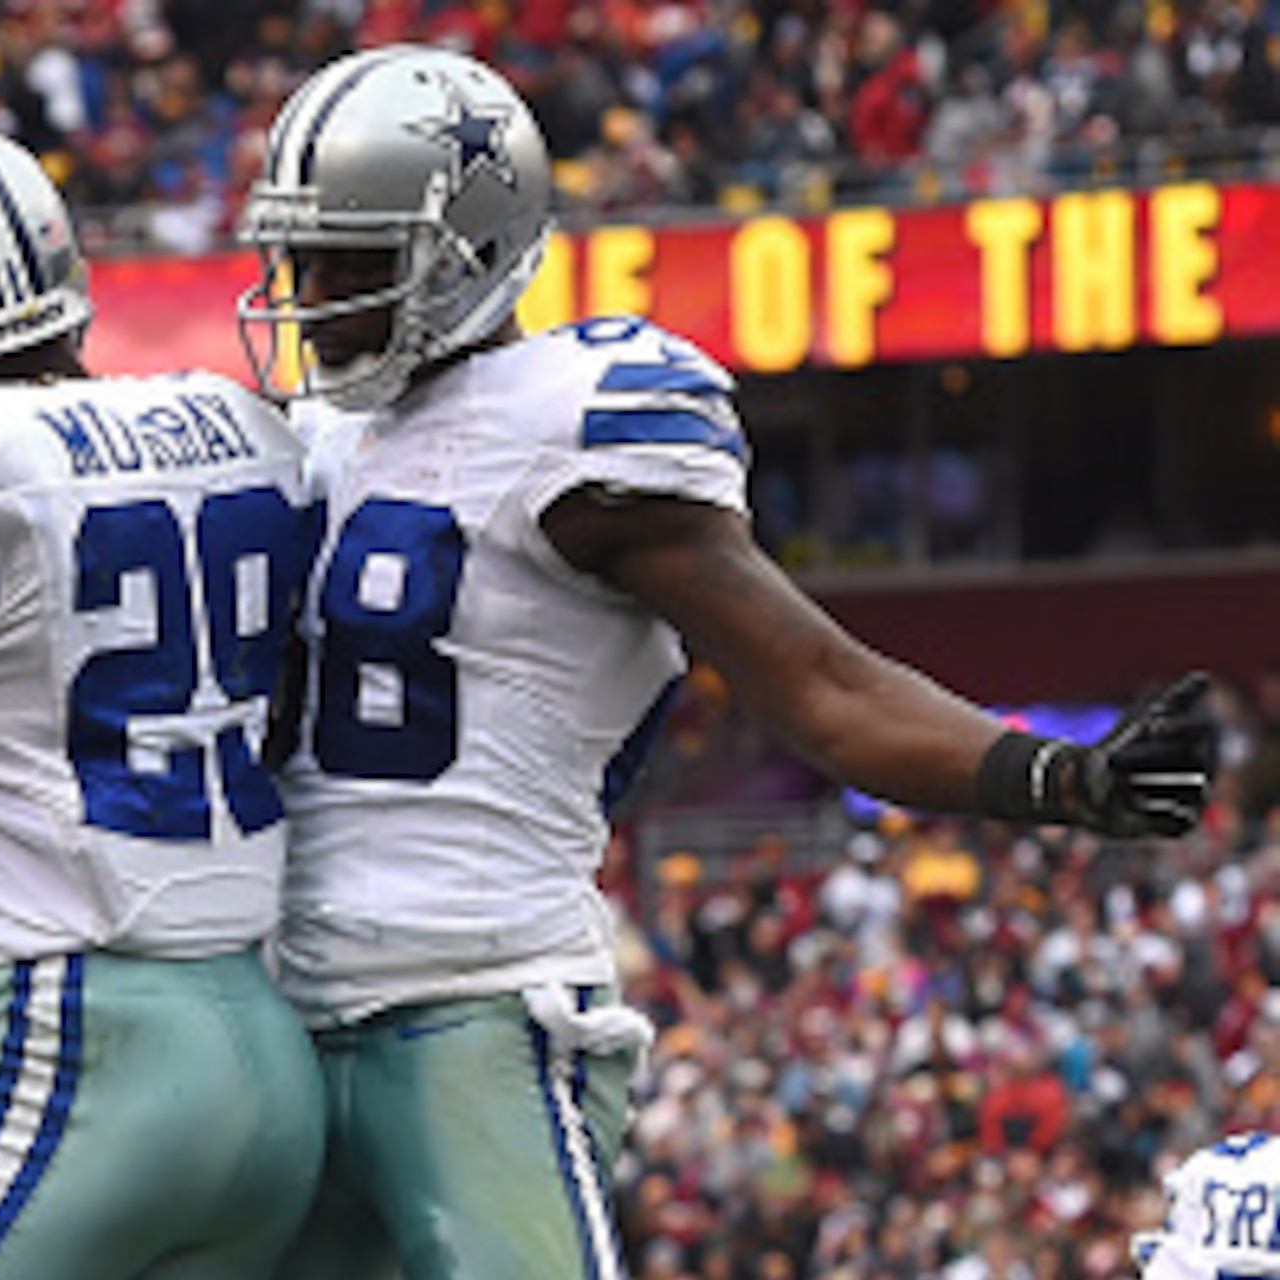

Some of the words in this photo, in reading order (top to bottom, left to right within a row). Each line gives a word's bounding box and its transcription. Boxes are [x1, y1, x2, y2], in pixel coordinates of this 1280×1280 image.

[728, 208, 894, 374] OF
[968, 182, 1224, 358] THE
[68, 486, 302, 840] 29
